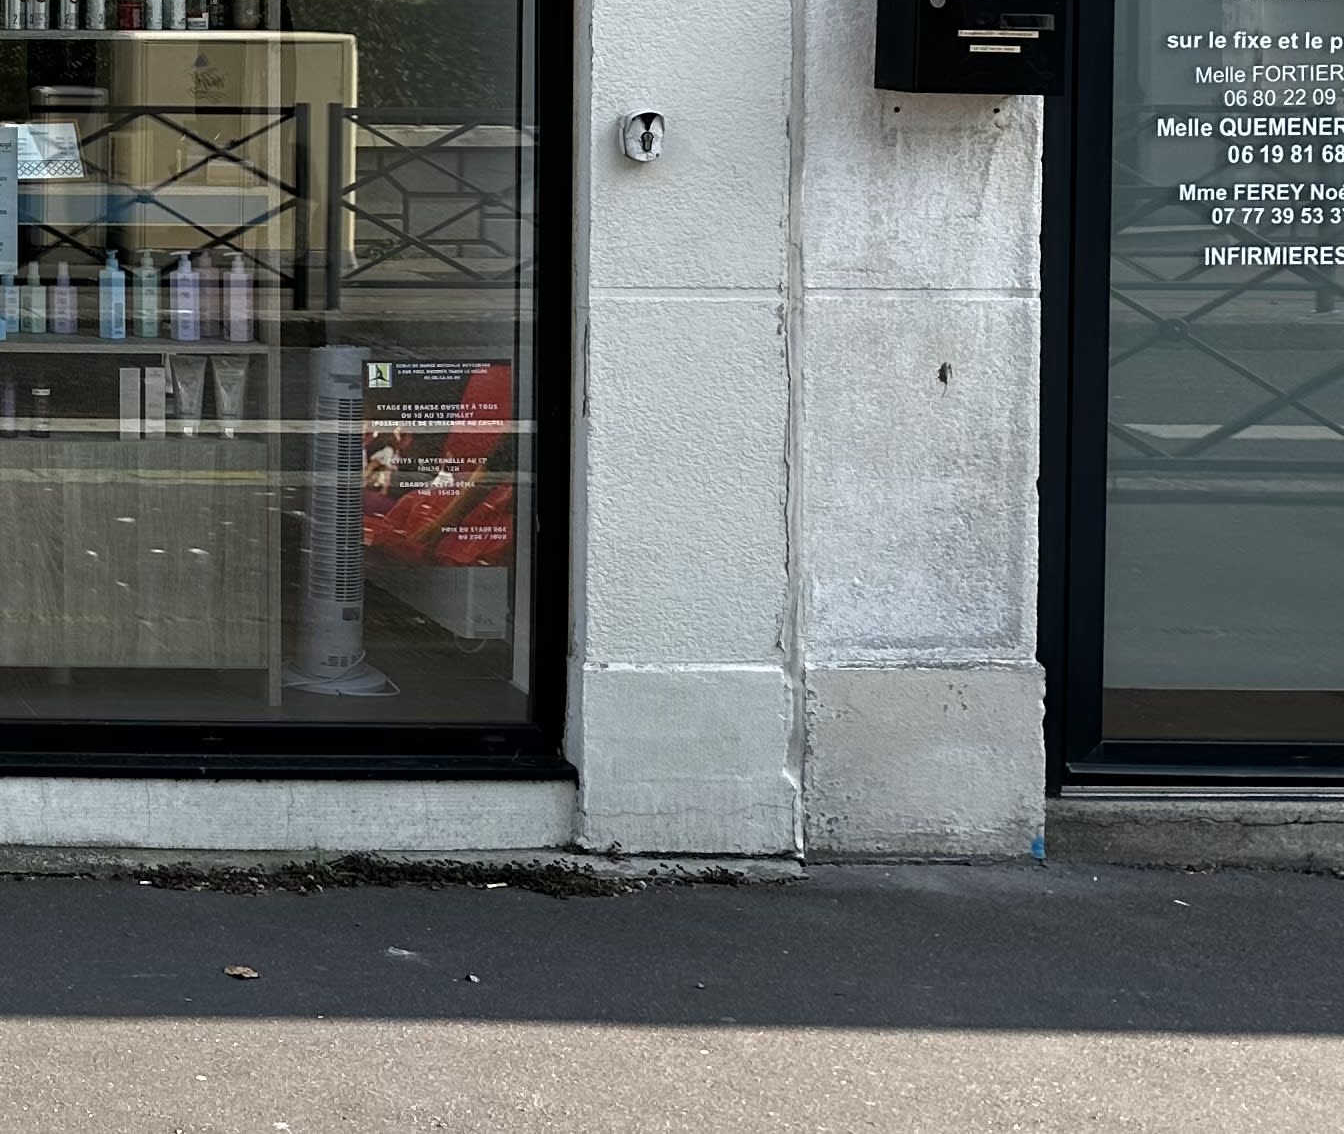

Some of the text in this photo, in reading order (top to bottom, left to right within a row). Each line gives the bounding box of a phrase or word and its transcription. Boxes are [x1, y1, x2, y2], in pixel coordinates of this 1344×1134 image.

[1167, 35, 1203, 49] sur
[1209, 31, 1227, 49] le
[1233, 30, 1272, 49] fixe
[1278, 32, 1299, 50] et
[1305, 31, 1323, 50] le
[1196, 64, 1344, 83] Melle FORTIER
[1224, 88, 1336, 107] 06 80 22 09
[1157, 117, 1344, 137] Melle QUEMENER
[1227, 144, 1344, 164] 06 19 81 68
[1179, 184, 1228, 201] Mme
[1234, 183, 1305, 201] FEREY
[1211, 207, 1344, 225] 07 77 39 53 3
[1204, 246, 1344, 266] INFIRMIERES
